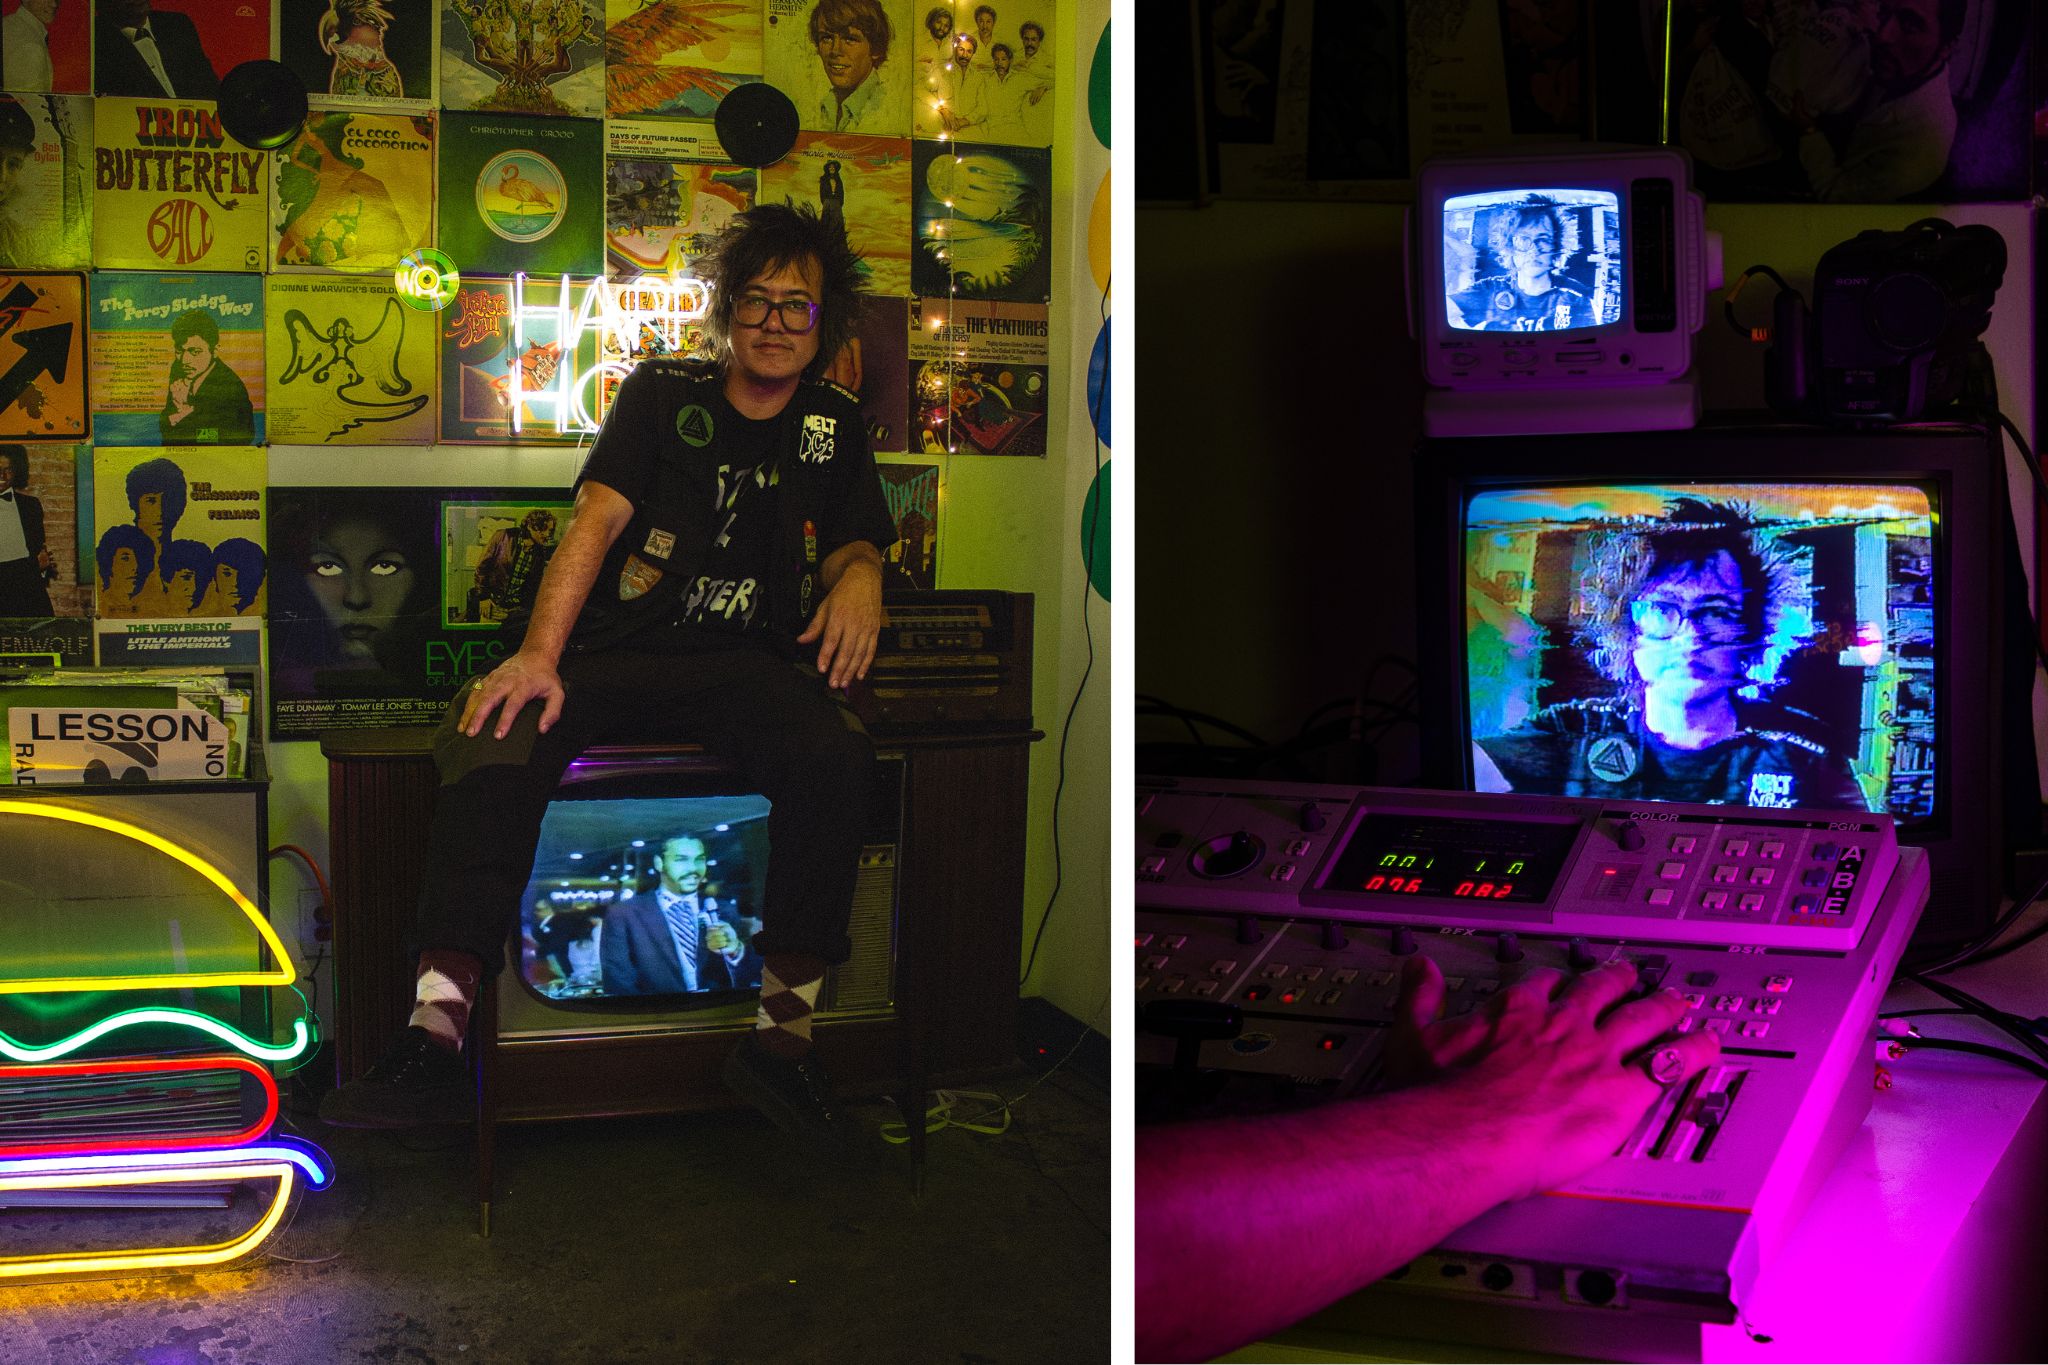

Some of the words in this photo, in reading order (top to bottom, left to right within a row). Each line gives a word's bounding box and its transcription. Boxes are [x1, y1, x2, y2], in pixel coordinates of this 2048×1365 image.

[136, 106, 225, 148] IRON
[347, 128, 364, 138] EL
[367, 129, 401, 139] COCO
[641, 134, 669, 142] FUTURE
[670, 136, 698, 144] PASSED
[42, 143, 60, 152] Bob
[346, 139, 429, 151] COCOMOTION
[34, 152, 61, 163] Dylan
[95, 148, 265, 195] BUTTERFLY
[147, 199, 214, 264] BALL
[1834, 278, 1869, 286] SONY
[271, 284, 309, 293] DIONNE
[311, 284, 368, 294] WARWICK'S
[370, 286, 397, 294] GOLD
[100, 298, 133, 312] The
[124, 304, 170, 320] Percy
[171, 294, 227, 312] Sledge
[219, 302, 253, 316] Way
[965, 316, 988, 334] THE
[988, 318, 1048, 337] VENTURES
[803, 414, 837, 435] MELT
[208, 509, 260, 520] FEELINGS
[126, 624, 150, 633] THE
[150, 623, 183, 633] VERY
[184, 622, 215, 632] BEST
[215, 622, 232, 631] OF
[168, 636, 231, 644] ANTHONY
[162, 642, 232, 650] IMPERIALS
[276, 704, 295, 713] FAYE
[297, 704, 336, 712] DUNAWAY
[341, 703, 370, 711] TOMMY
[372, 702, 385, 710] LEE
[386, 702, 412, 710] JONES
[414, 701, 437, 709] "EYES
[438, 701, 450, 709] OF
[31, 713, 208, 742] LESSON
[205, 744, 224, 777] NO
[1630, 812, 1679, 822] COLOR
[1827, 822, 1861, 832] PGM
[1840, 845, 1862, 862] A
[1831, 871, 1856, 889] B
[1822, 897, 1847, 914] E
[1439, 926, 1476, 936] DFX
[1728, 944, 1767, 955] DSK
